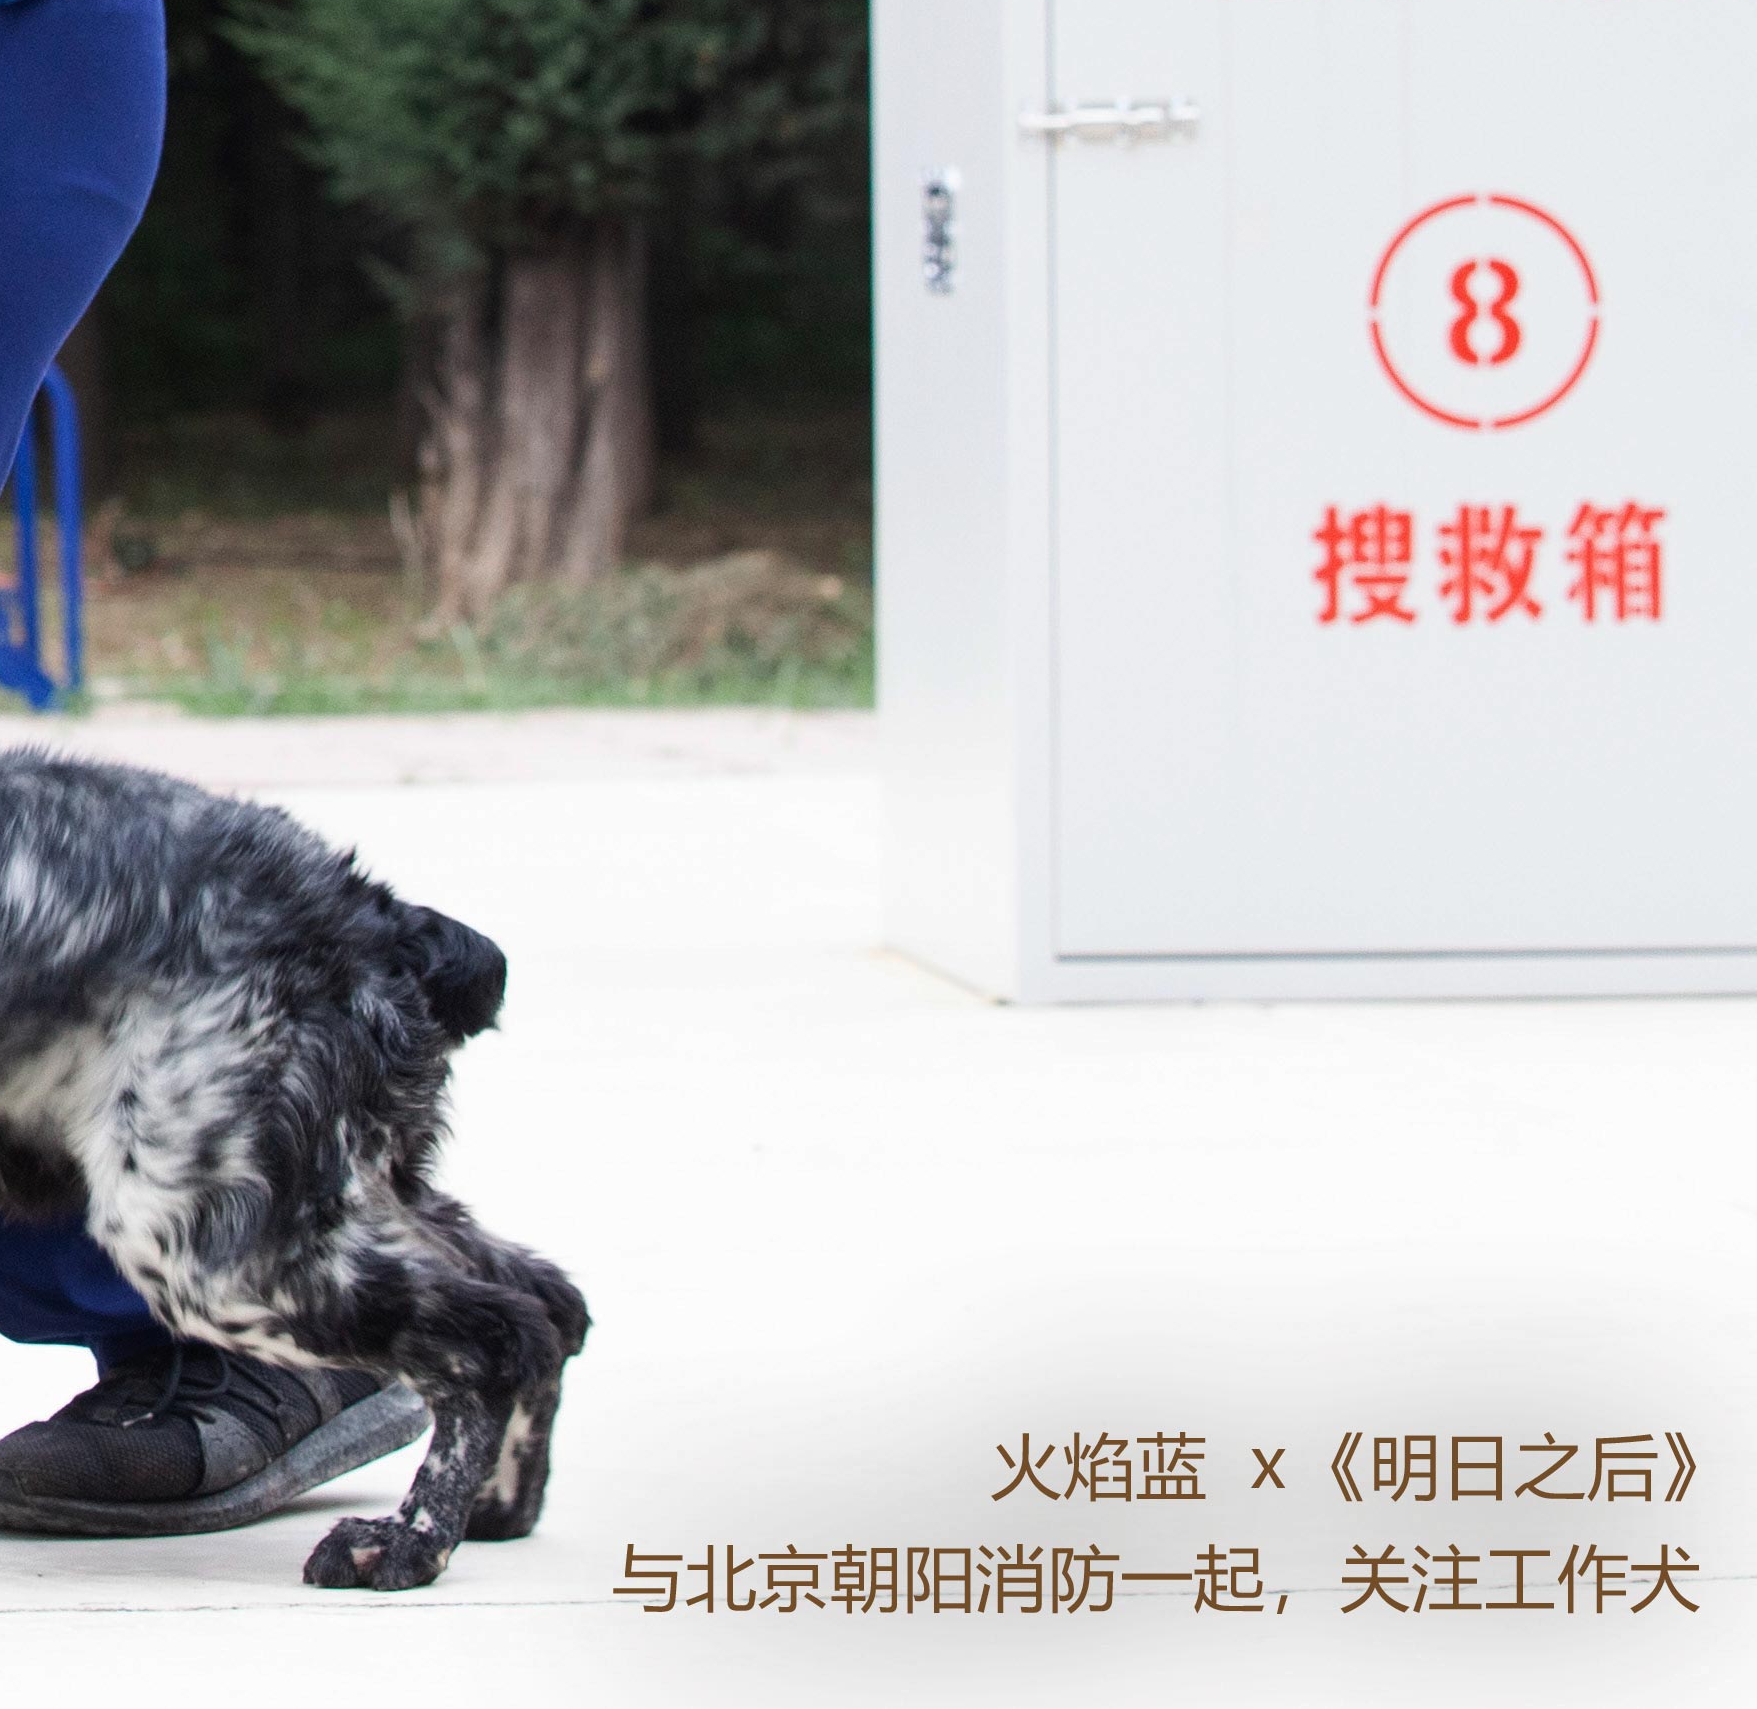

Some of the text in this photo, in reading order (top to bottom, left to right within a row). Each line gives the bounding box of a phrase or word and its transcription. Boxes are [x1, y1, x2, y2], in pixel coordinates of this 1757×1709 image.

[1446, 257, 1524, 368] 8
[1311, 498, 1668, 628] 搜救箱
